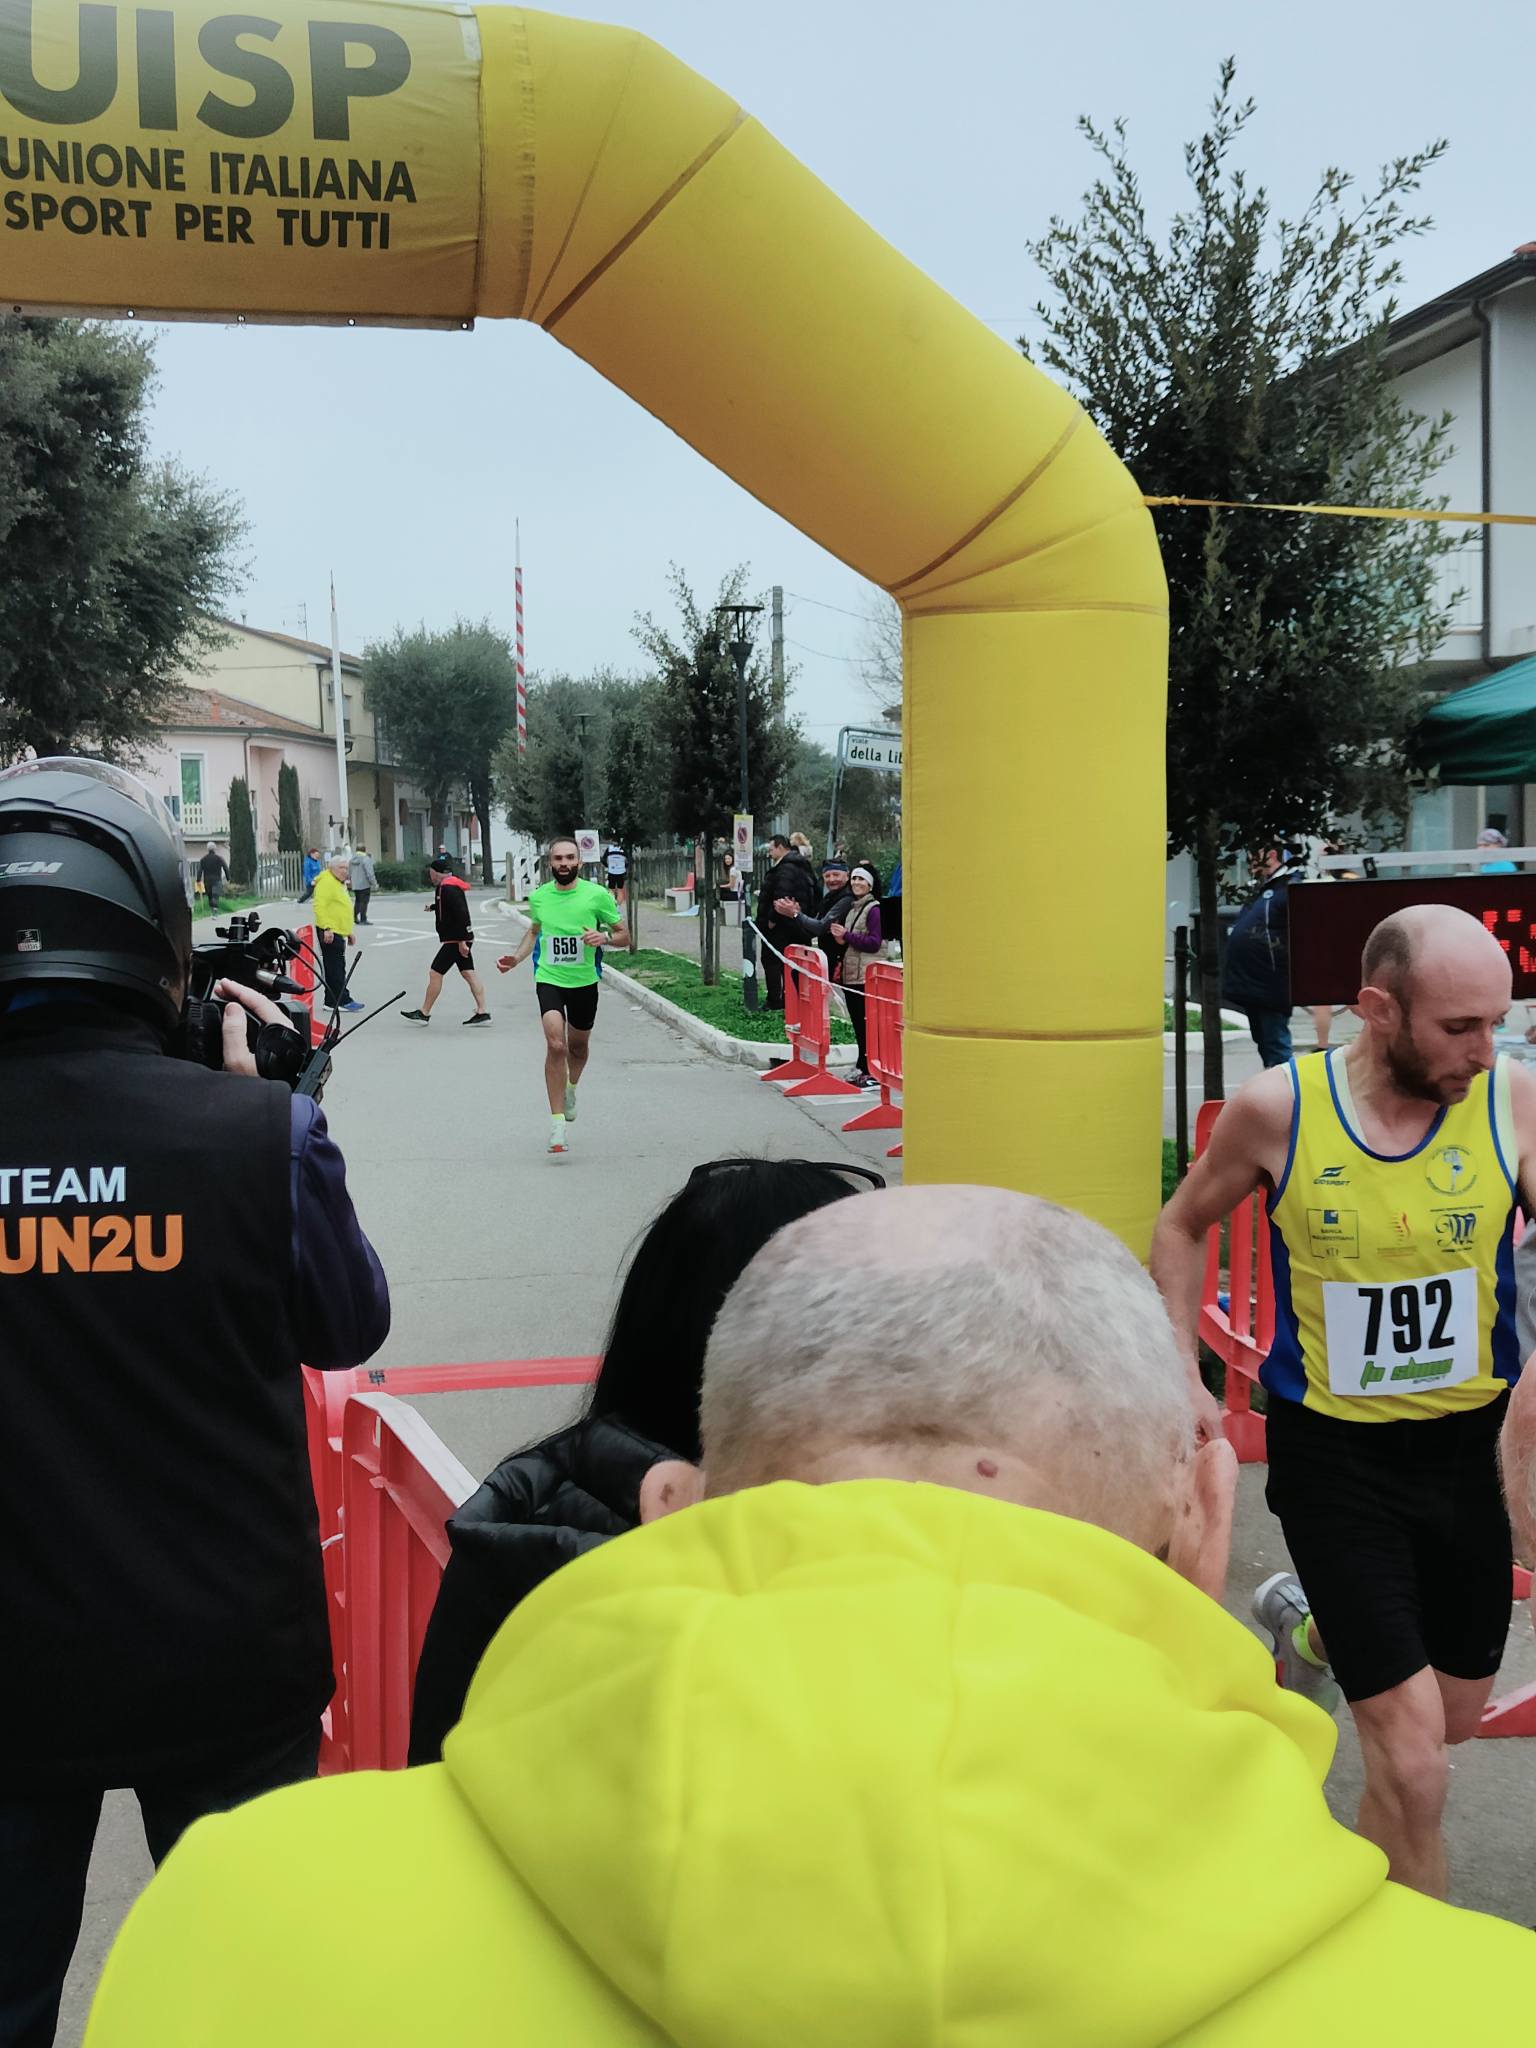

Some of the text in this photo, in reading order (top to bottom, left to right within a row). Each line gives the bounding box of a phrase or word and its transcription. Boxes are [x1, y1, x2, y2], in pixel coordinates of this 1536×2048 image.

[0, 1, 412, 141] UISP
[0, 136, 418, 203] UNIONE ITALIANA
[5, 190, 391, 250] SPORT PER TUTTI
[850, 746, 882, 761] della
[553, 937, 577, 955] 658
[0, 1166, 127, 1205] TEAM
[1358, 1278, 1455, 1356] 792
